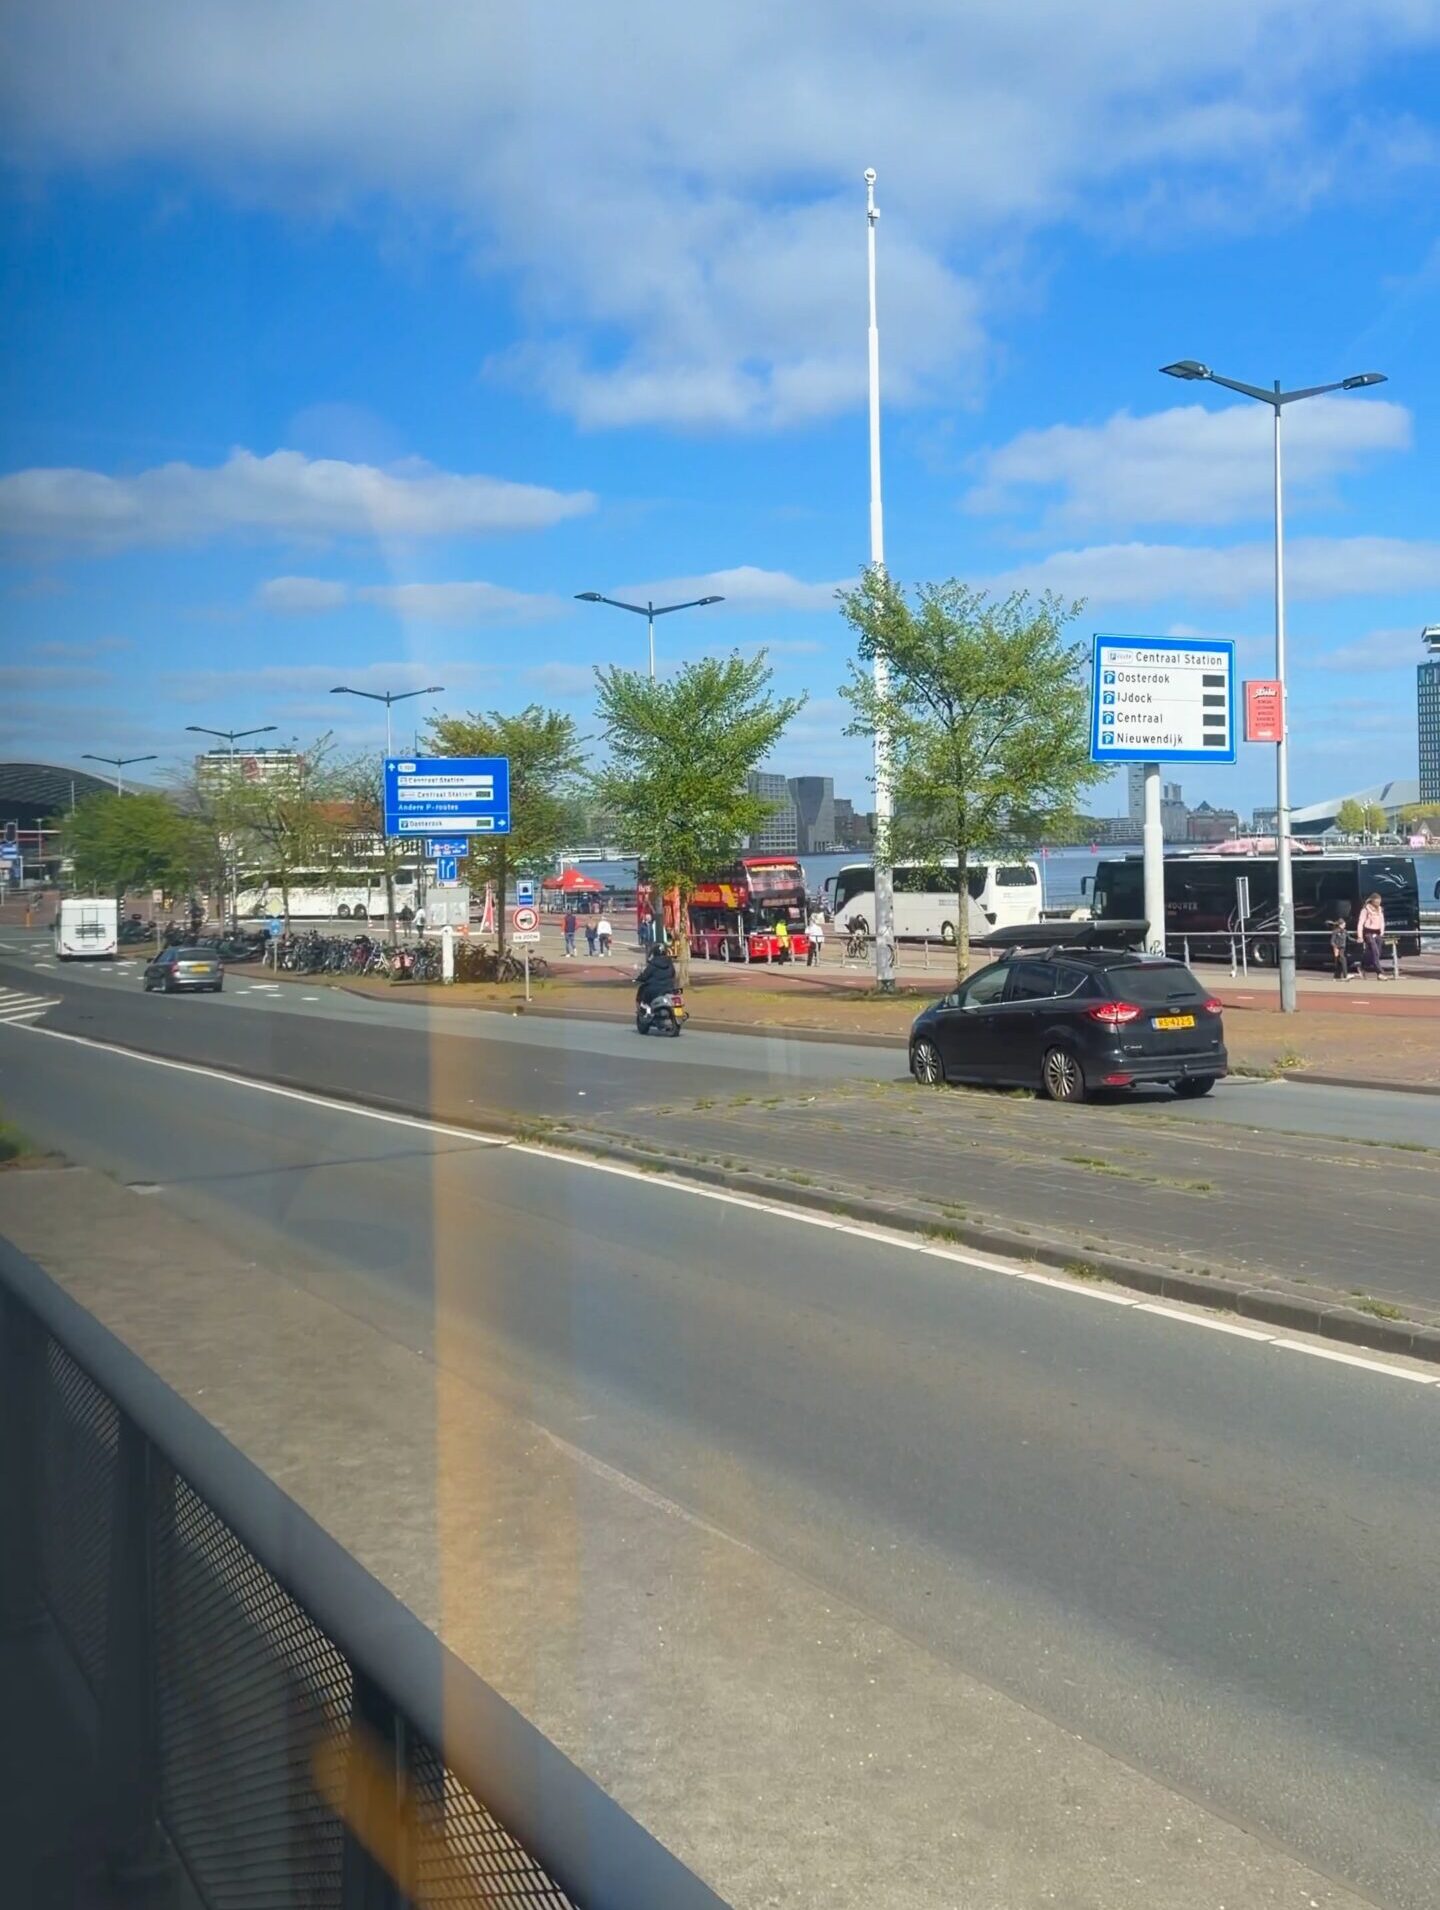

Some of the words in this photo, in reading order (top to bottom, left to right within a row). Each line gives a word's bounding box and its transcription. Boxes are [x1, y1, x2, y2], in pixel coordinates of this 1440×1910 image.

[1136, 652, 1180, 663] Centraal
[1184, 654, 1222, 665] Station
[1118, 672, 1170, 683] Oosterdok
[1118, 692, 1152, 703] IJdock
[1117, 712, 1163, 723] Centraal
[1117, 733, 1183, 747] Nieuwendijk
[398, 803, 424, 811] Andere
[426, 803, 459, 811] P-routes
